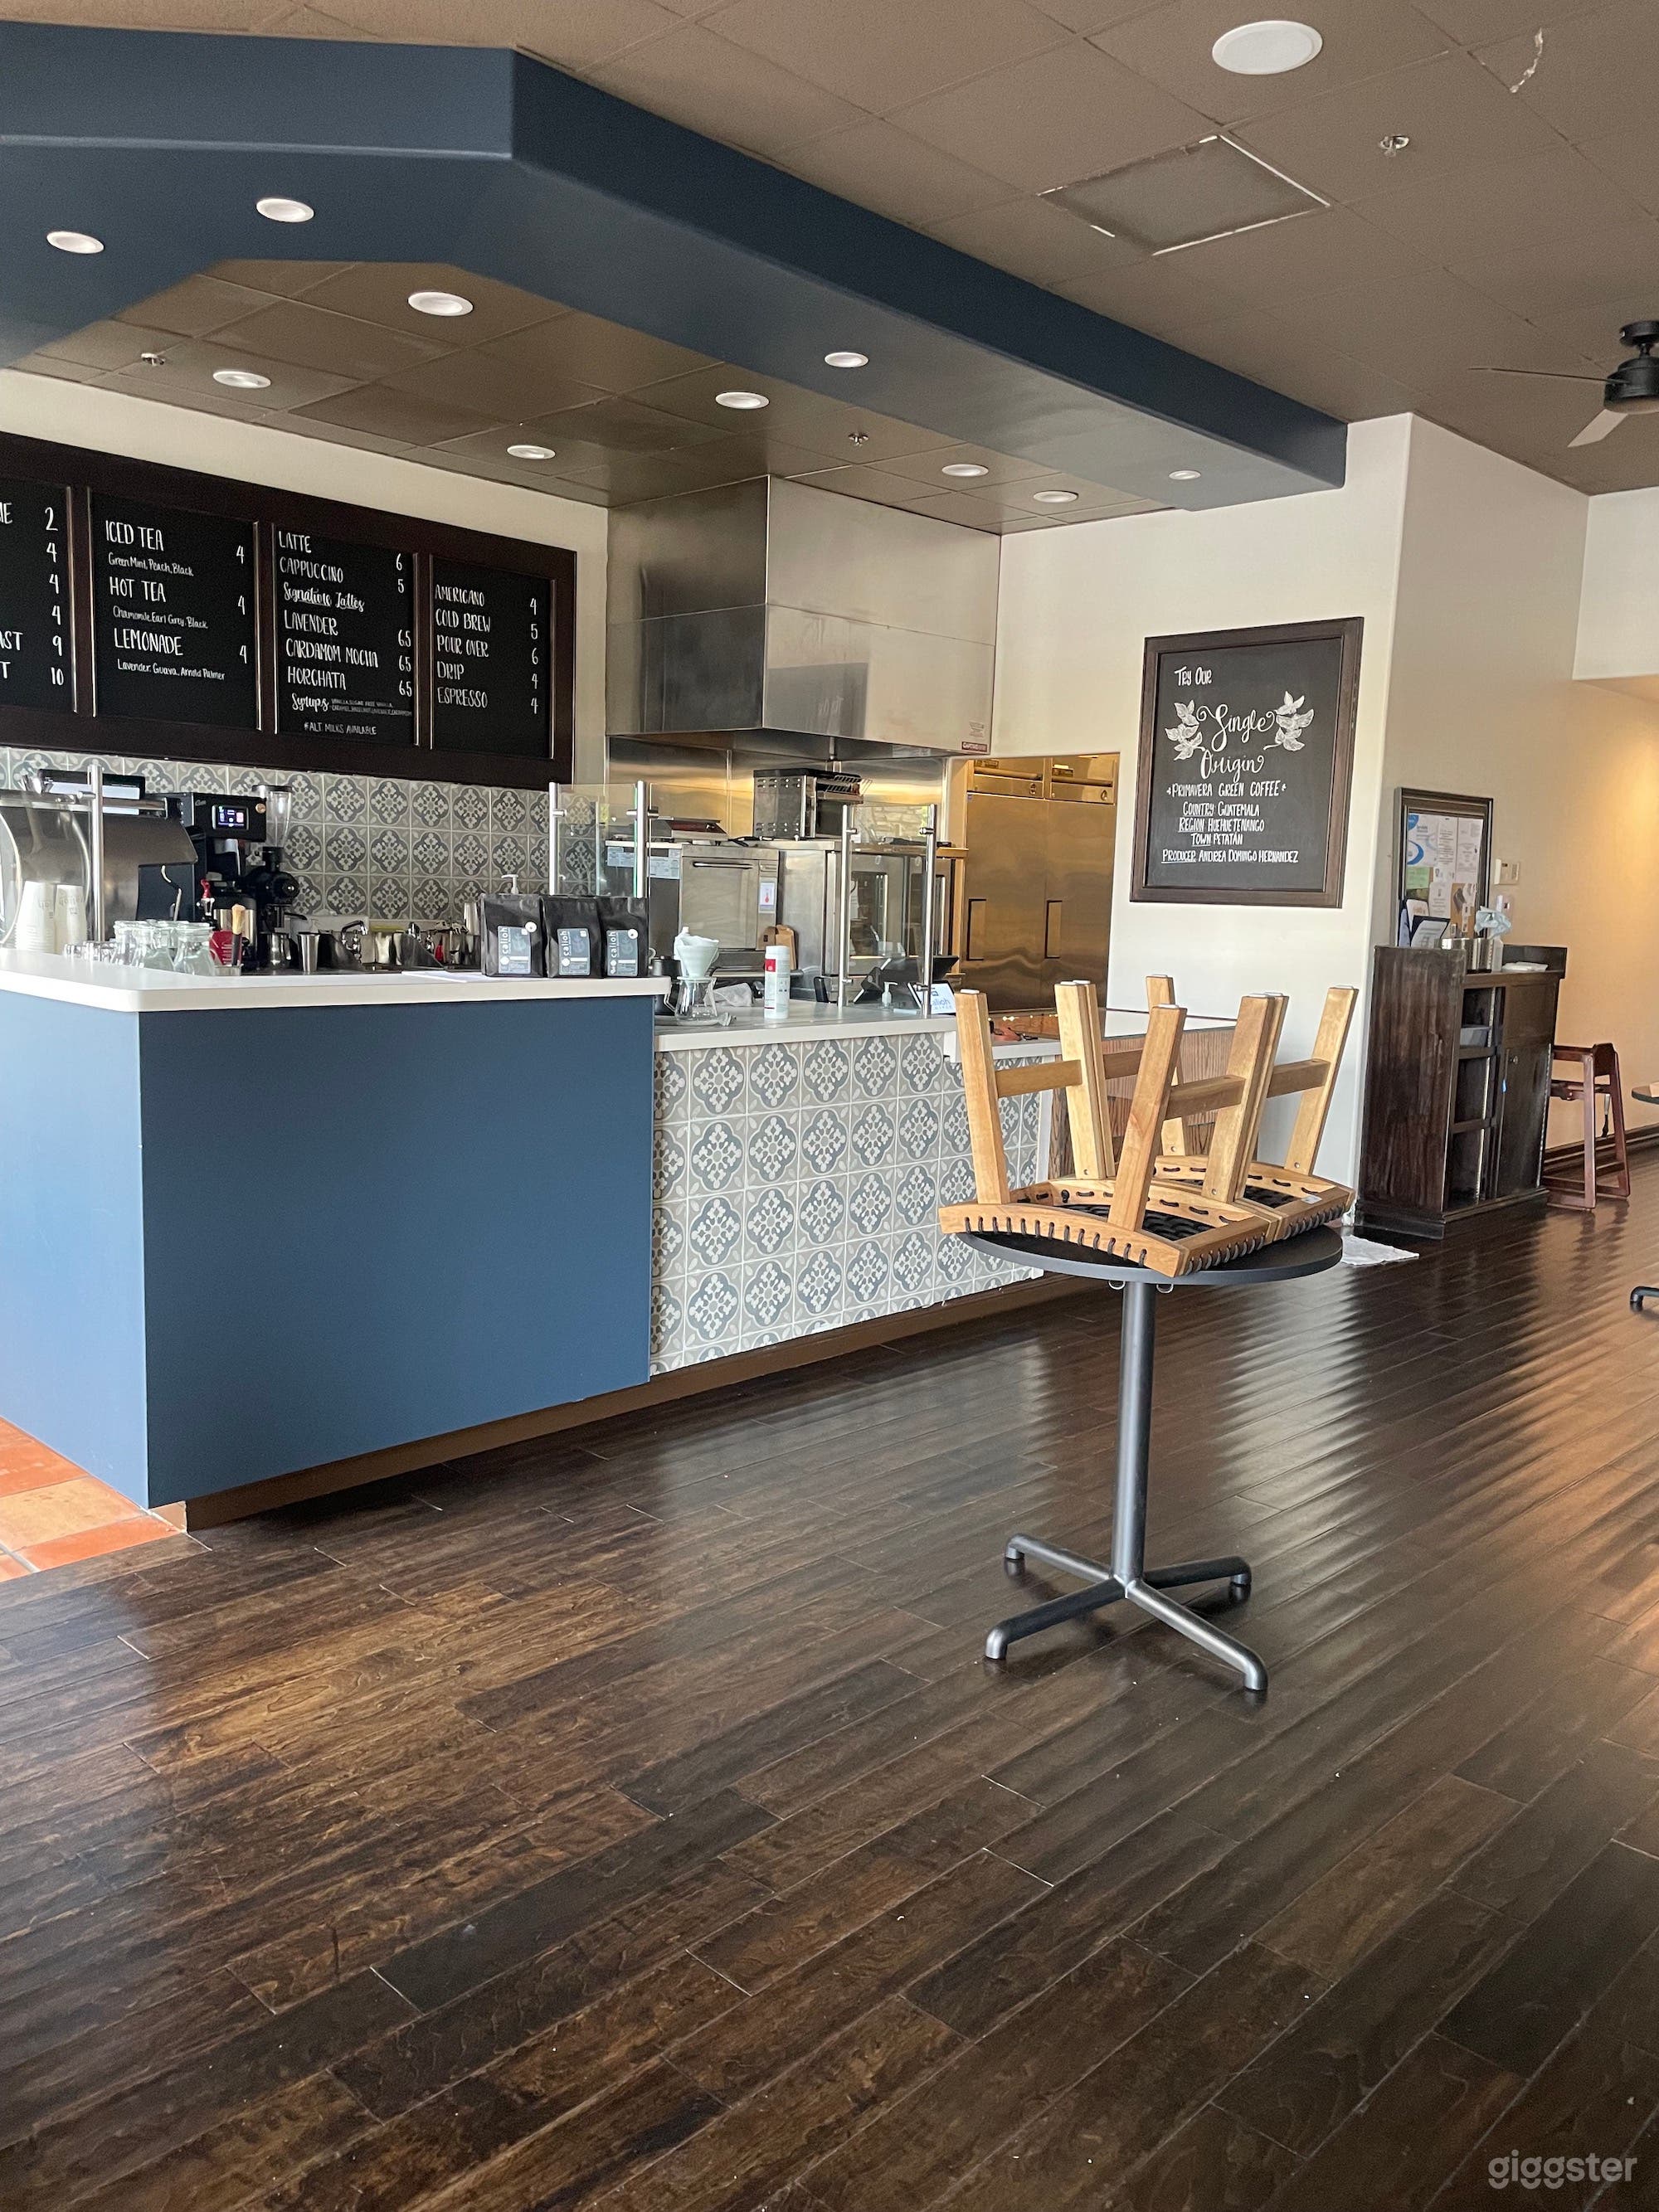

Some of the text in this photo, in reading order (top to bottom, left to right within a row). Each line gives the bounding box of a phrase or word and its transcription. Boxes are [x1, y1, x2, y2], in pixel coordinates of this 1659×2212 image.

[45, 507, 58, 531] 2
[46, 542, 57, 562] 4
[105, 520, 245, 564] ICED TEA 4
[279, 530, 403, 571] LATTE 6
[172, 562, 194, 576] Black
[279, 556, 405, 594] CAPPUCCINO 5
[49, 574, 59, 594] 4
[109, 576, 246, 615] HOT TEA 4
[435, 584, 538, 616] AMERICANO 4
[51, 605, 61, 625] 4
[186, 616, 208, 629] Black
[284, 609, 338, 636] LAVENDER
[435, 608, 538, 640] COLD BREW 5
[52, 635, 62, 656] 9
[114, 627, 247, 664] LEMONADE 4
[285, 637, 342, 663] CARDAMOM
[345, 646, 379, 668] MOCHA
[436, 634, 539, 665] POUR OVER 6
[51, 668, 64, 685] 10
[202, 668, 226, 681] Palmer
[287, 665, 347, 691] HORCHATA
[436, 660, 538, 690] DRIP 4
[291, 692, 330, 712] Syrups
[436, 686, 539, 715] ESPRESSO 4
[324, 723, 344, 734] MILKS
[346, 724, 377, 736] AVAILABLE
[1196, 703, 1276, 752] Single
[1200, 749, 1265, 783] Origin
[1171, 780, 1282, 798] PRIMAVERA GREEN COFFEE
[1217, 800, 1260, 816] GUATEMALA
[1198, 849, 1227, 863] ANDREA
[1228, 848, 1257, 863] DOMINGO
[1258, 849, 1299, 863] HERNANDEZ
